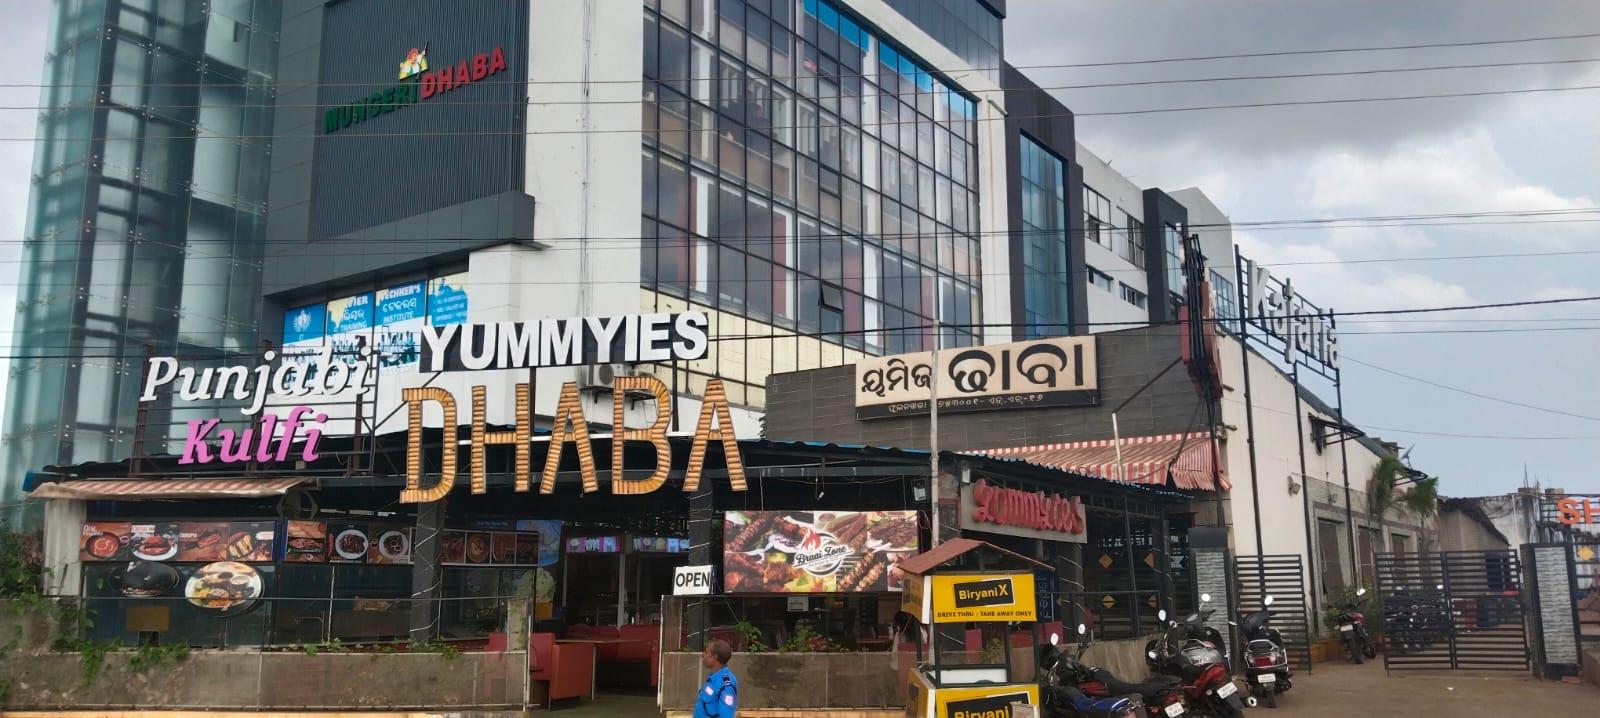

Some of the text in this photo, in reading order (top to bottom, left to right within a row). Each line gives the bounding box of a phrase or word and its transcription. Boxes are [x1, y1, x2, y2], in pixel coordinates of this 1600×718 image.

[325, 47, 506, 133] MUNGERI DHABA
[383, 311, 414, 323] INSTITUTE
[420, 311, 708, 371] YUMMYIES
[139, 345, 372, 415] Punjabi
[948, 343, 1084, 393] ଢାବା
[177, 406, 329, 465] Kulfi
[399, 375, 748, 504] DHABA
[675, 572, 710, 587] OPEN
[795, 551, 824, 565] Braai
[823, 546, 848, 557] Zone
